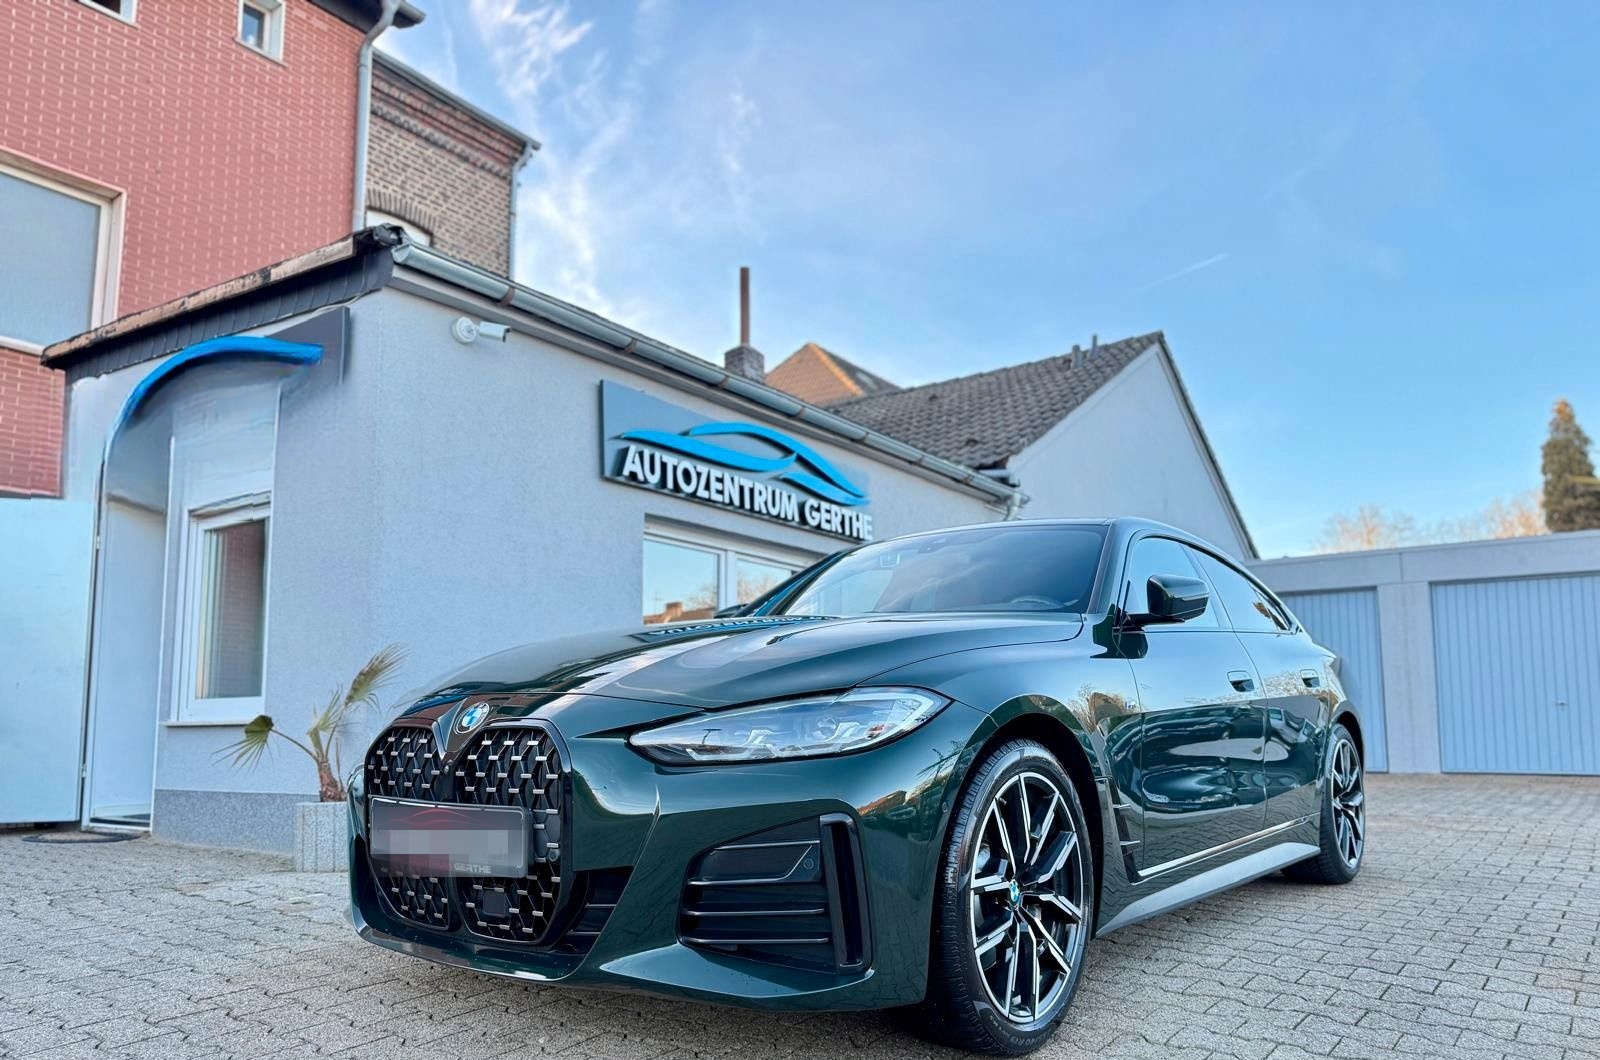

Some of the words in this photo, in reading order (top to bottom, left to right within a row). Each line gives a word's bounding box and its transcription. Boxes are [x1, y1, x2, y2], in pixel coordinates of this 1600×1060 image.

[622, 445, 799, 522] AUTOZENTRUM
[804, 499, 873, 540] GERTHE
[453, 862, 492, 874] GERTHE
